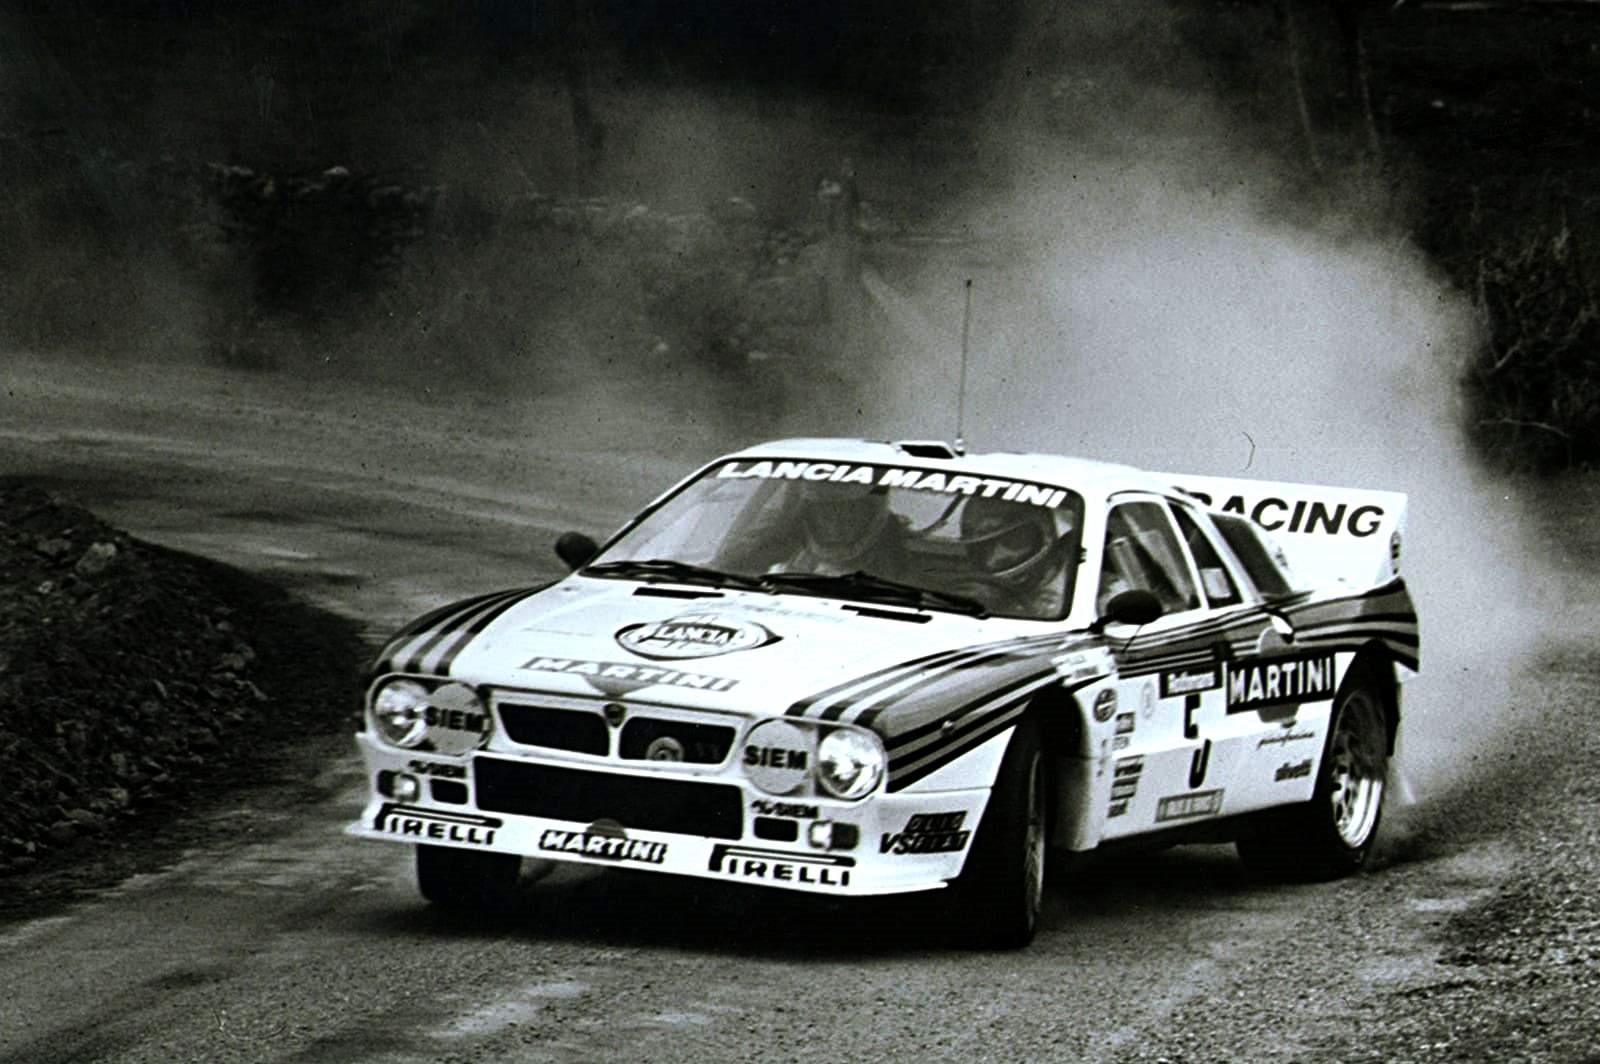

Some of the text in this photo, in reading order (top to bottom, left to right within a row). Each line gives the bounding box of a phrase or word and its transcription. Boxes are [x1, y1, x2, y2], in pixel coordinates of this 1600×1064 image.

[718, 462, 1068, 508] LANCIA MARTINI
[655, 623, 736, 647] LANCIA
[522, 657, 739, 691] MARTINI
[1230, 657, 1332, 704] MARTINI
[743, 745, 808, 770] SIEM
[375, 803, 503, 845] PIRELLI
[540, 830, 668, 863] MARTINI
[708, 844, 857, 887] PIRELLI
